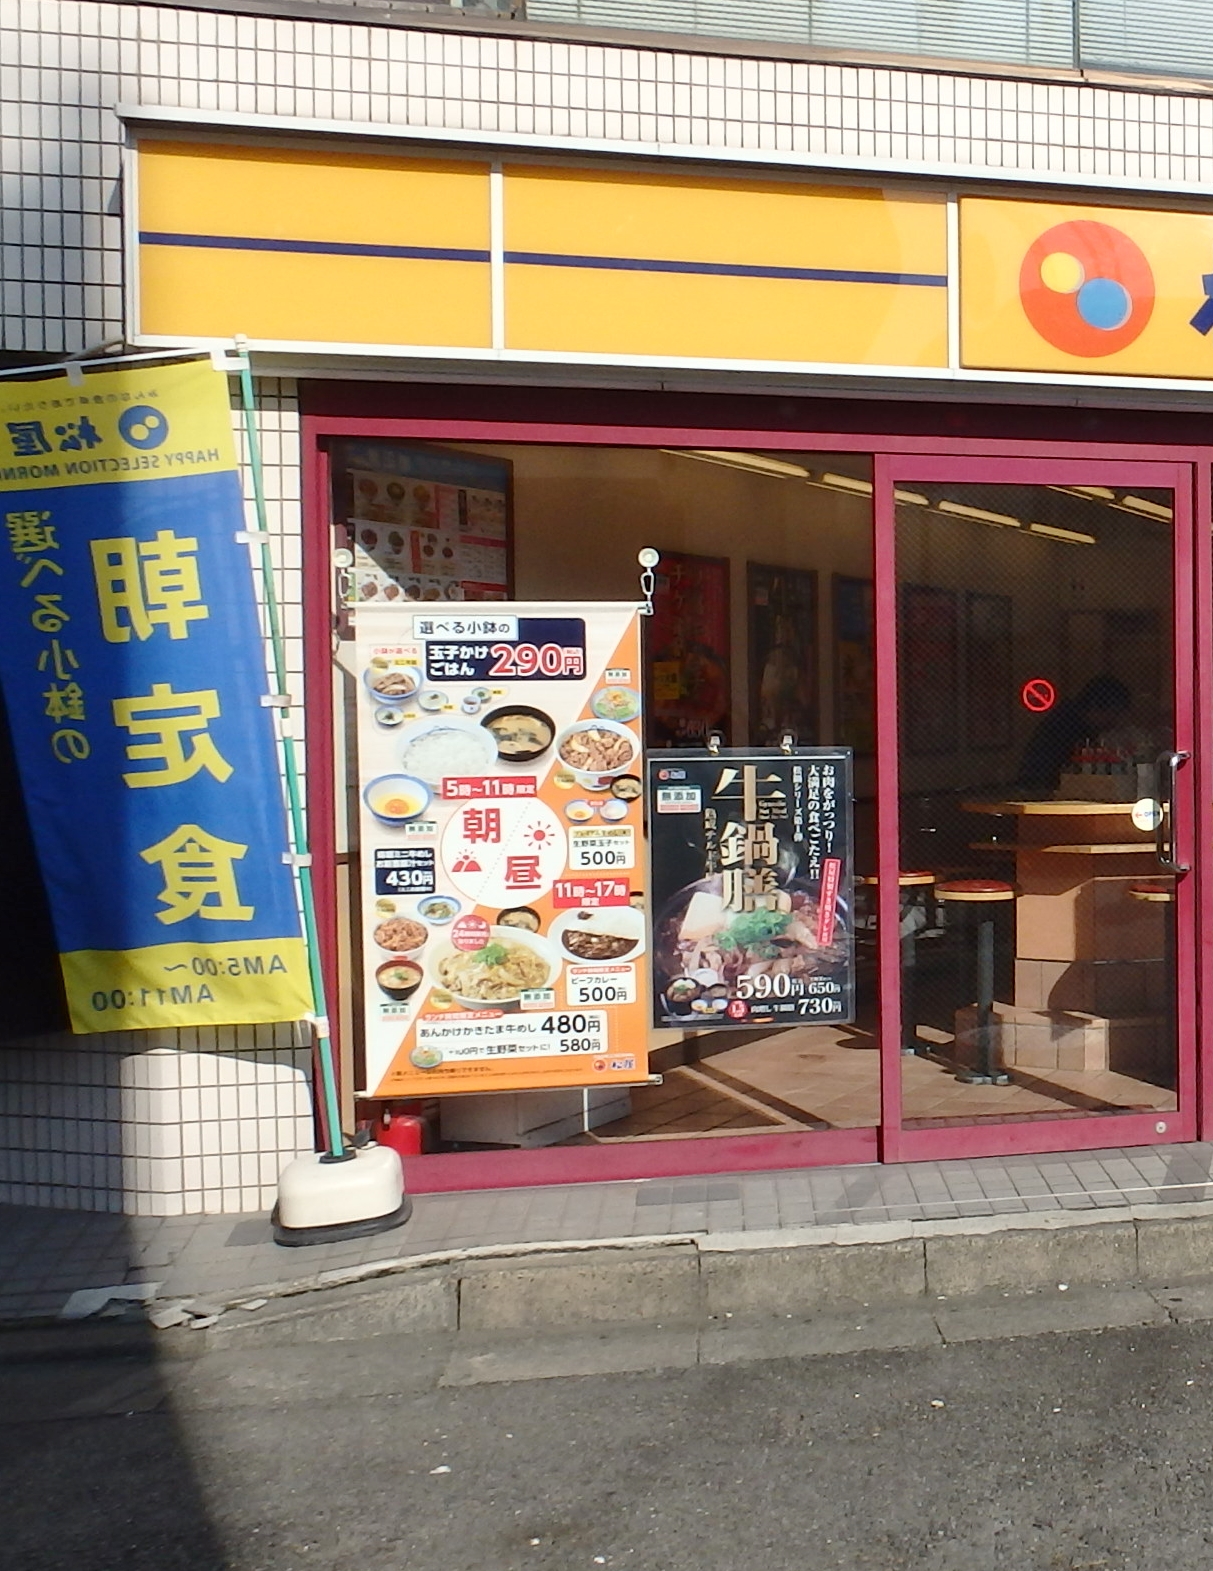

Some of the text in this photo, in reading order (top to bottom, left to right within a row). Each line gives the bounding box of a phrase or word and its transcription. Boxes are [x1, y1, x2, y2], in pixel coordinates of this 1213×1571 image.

[419, 621, 510, 635] 選べる小鉢の
[428, 645, 489, 660] 玉子かけ
[489, 643, 584, 676] 290円
[430, 662, 475, 676] ごはん
[822, 764, 836, 853] お肉をがっつり!
[463, 808, 500, 844] 朝
[808, 764, 821, 880] 大満足の食べごたえ!!
[711, 765, 788, 913] 牛鍋膳
[580, 851, 626, 866] 500円
[385, 870, 434, 886] 430円
[505, 855, 542, 889] 昼
[571, 977, 618, 985] ビーフカレー
[736, 973, 804, 999] 590円
[808, 982, 841, 994] 650円
[579, 987, 627, 1002] 500円
[798, 997, 842, 1015] 730円
[420, 1023, 537, 1038] あんかけかきたま牛めし
[541, 1015, 600, 1035] 480円
[560, 1038, 600, 1053] 580円
